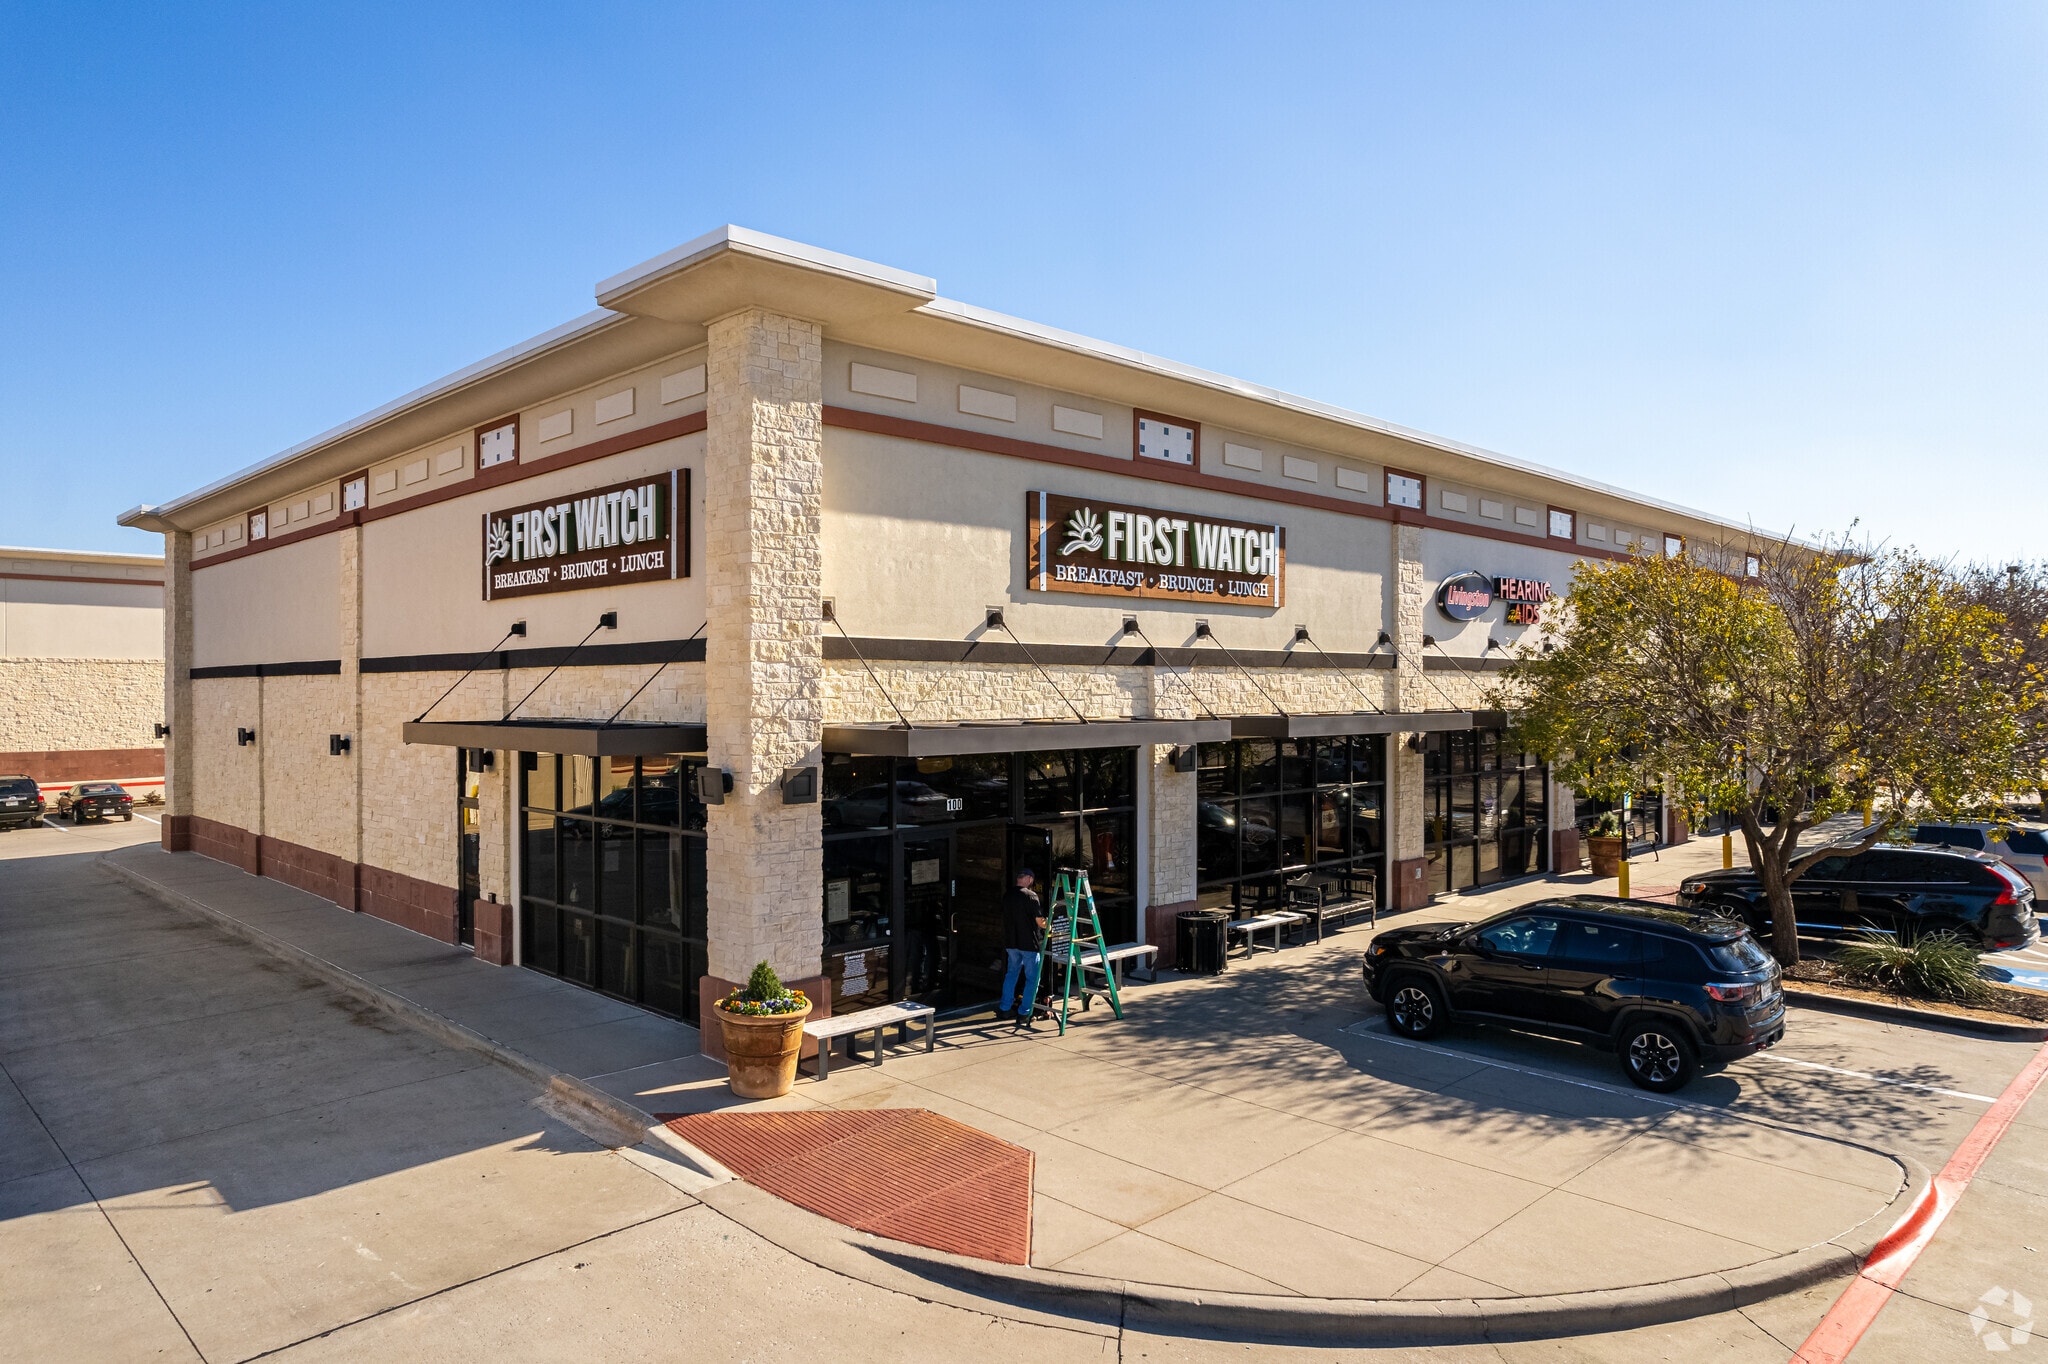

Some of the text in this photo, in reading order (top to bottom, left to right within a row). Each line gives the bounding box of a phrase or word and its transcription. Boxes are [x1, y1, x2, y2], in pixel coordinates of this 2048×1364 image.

[512, 484, 657, 563] FIRST WATCH
[1107, 510, 1276, 576] FIRST WATCH
[494, 550, 665, 590] BREAKFAST BRUNCH LUNCH
[1055, 564, 1269, 597] BREAKFAST BRUNCH LUNCH
[1447, 585, 1490, 611] Livingston
[1500, 577, 1552, 602] HEARING
[1515, 604, 1540, 625] AIDS
[947, 798, 963, 811] 100
